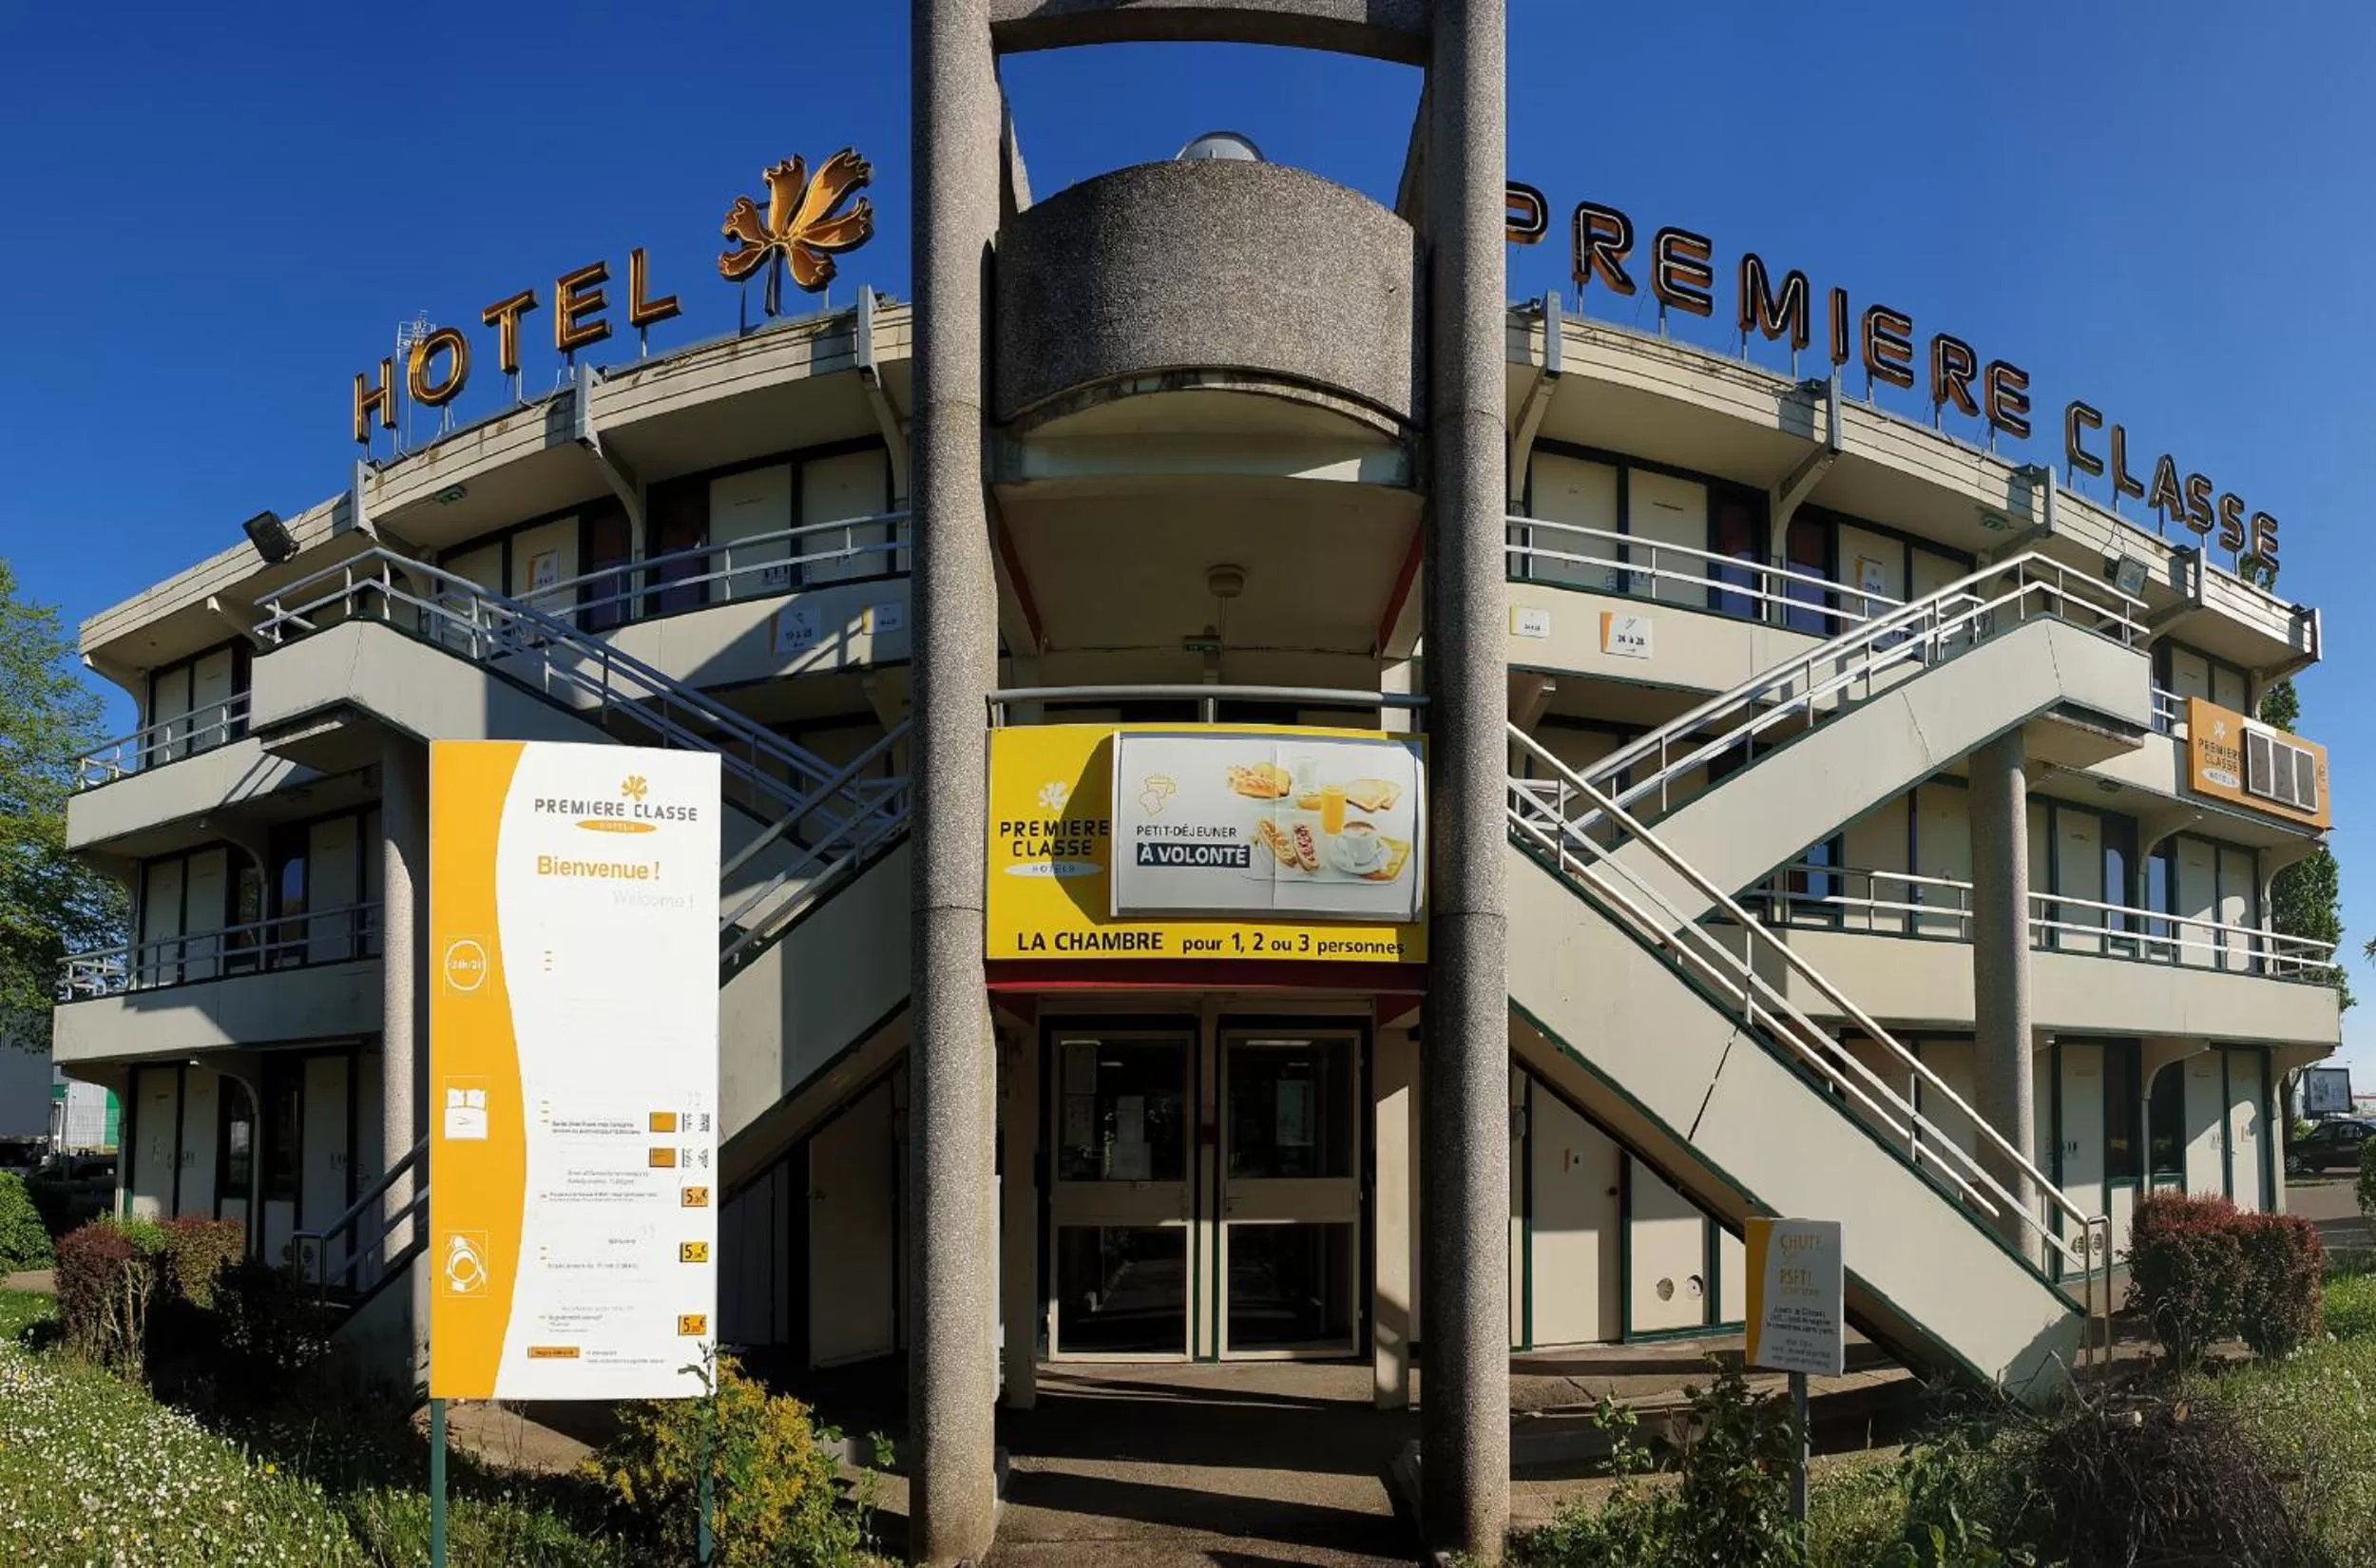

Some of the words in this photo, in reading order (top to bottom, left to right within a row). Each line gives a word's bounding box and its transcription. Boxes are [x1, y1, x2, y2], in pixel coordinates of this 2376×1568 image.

[354, 245, 682, 445] HOTEL
[2065, 400, 2280, 570] CLASSE
[2204, 752, 2238, 773] CLASSE
[535, 797, 624, 818] PREMIERE
[634, 803, 698, 822] CLASSE
[1000, 820, 1110, 838] PREMIERE
[1137, 824, 1236, 837] PETIT-DÉJEUNER
[1012, 839, 1093, 857] CLASSE
[1140, 842, 1154, 862] À
[1158, 843, 1247, 865] VOLONTÉ
[537, 854, 648, 880] Bienvenue
[655, 860, 661, 880] !
[1018, 932, 1047, 950] LA
[1054, 931, 1164, 950] CHAMBRE
[1182, 938, 1223, 954] pour
[1232, 932, 1245, 953] 1,
[1253, 931, 1264, 951] 2
[1271, 939, 1293, 951] ou
[1297, 933, 1310, 951] 3
[1317, 938, 1406, 955] personnes
